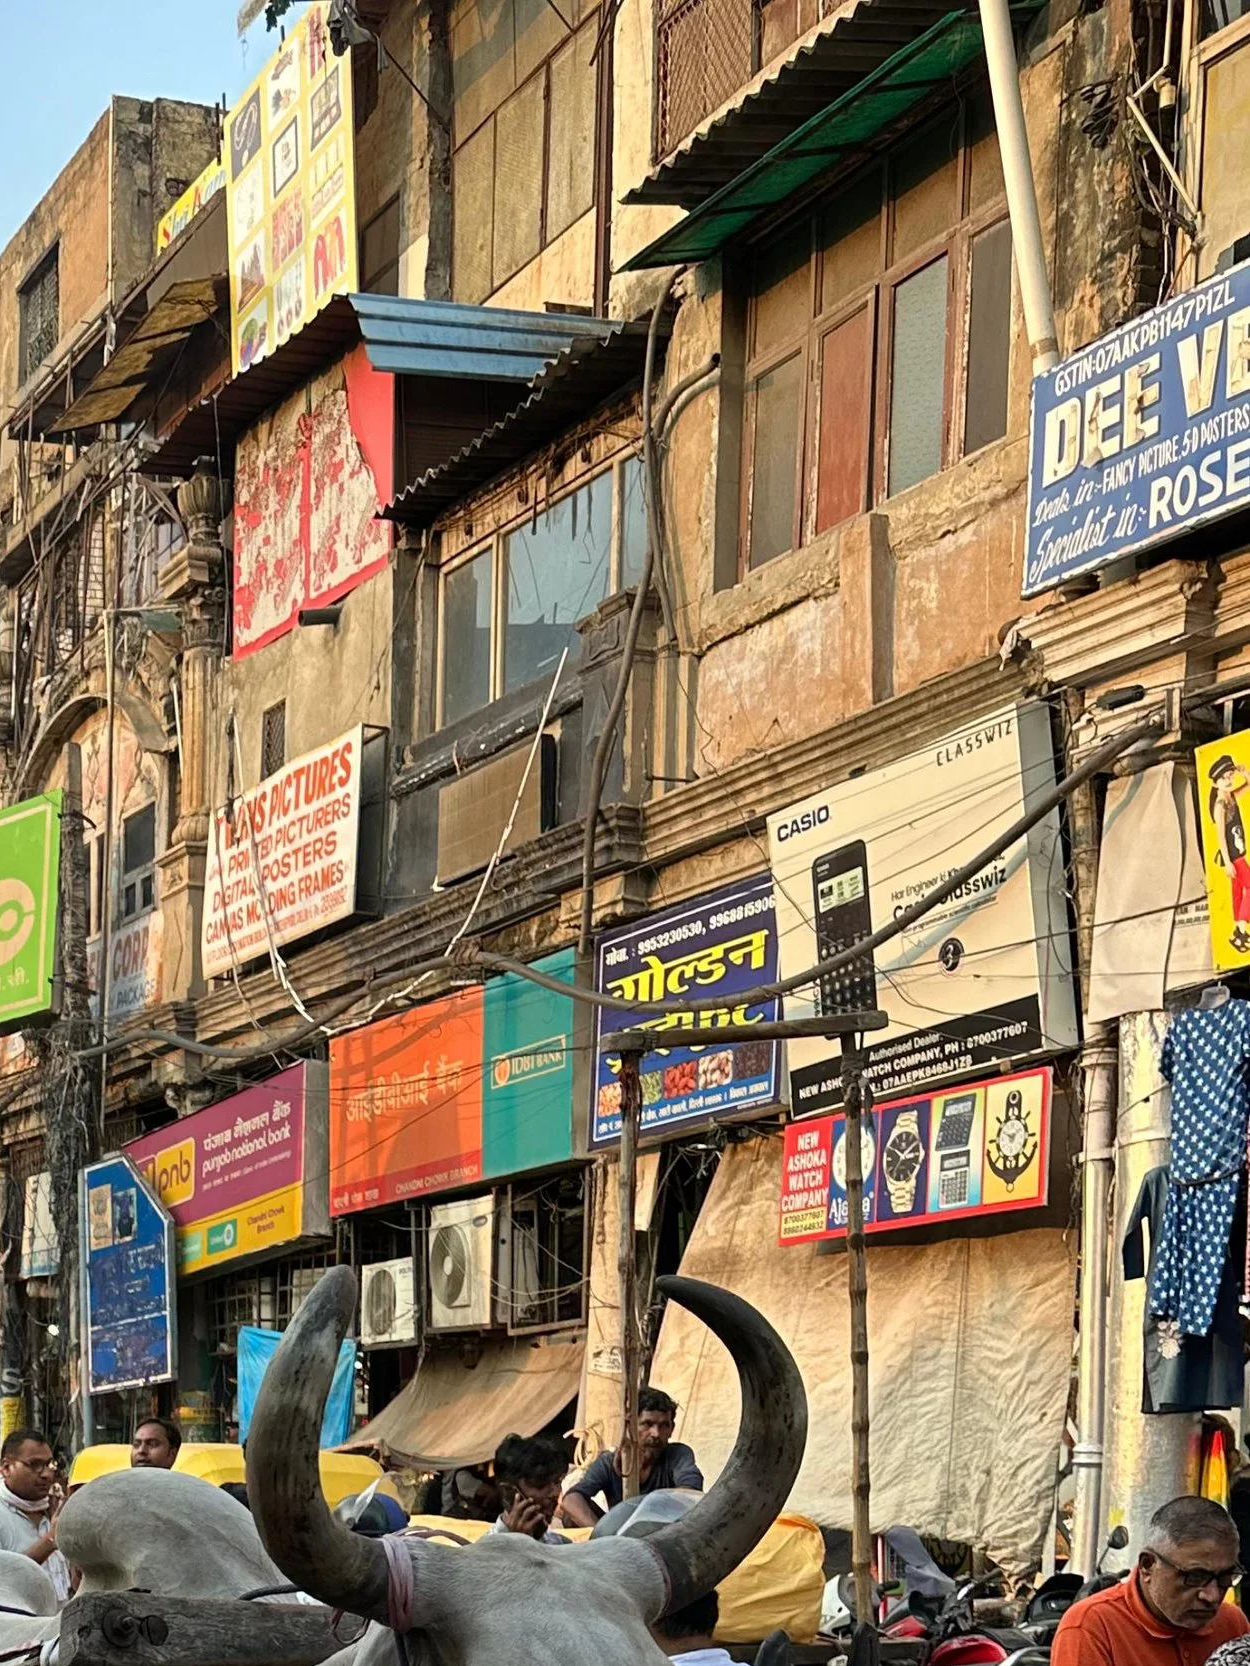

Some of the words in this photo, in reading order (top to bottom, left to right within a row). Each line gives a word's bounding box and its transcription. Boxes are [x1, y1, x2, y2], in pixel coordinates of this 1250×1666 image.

[1042, 351, 1161, 489] DEE
[1177, 309, 1250, 419] VE
[1029, 508, 1117, 583] Specialist
[1148, 439, 1250, 529] ROSE
[1032, 491, 1070, 527] Deals
[1102, 459, 1136, 495] FANCY
[936, 718, 1013, 767] CLASSWIZ
[268, 741, 353, 827] PICTURES
[274, 792, 352, 847] PICTURERS
[777, 804, 831, 843] CASIO
[262, 830, 338, 884] POSTERS
[298, 860, 344, 901] FRAMES
[511, 1058, 535, 1076] IDBI
[536, 1050, 563, 1068] BANK
[869, 1038, 912, 1062] Authorised
[799, 1081, 821, 1099] NEW
[787, 1149, 827, 1173] ASHOKA
[798, 1131, 820, 1151] NEW
[158, 1157, 192, 1198] pnb
[789, 1170, 823, 1191] WATCH
[782, 1187, 829, 1212] COMPANY
